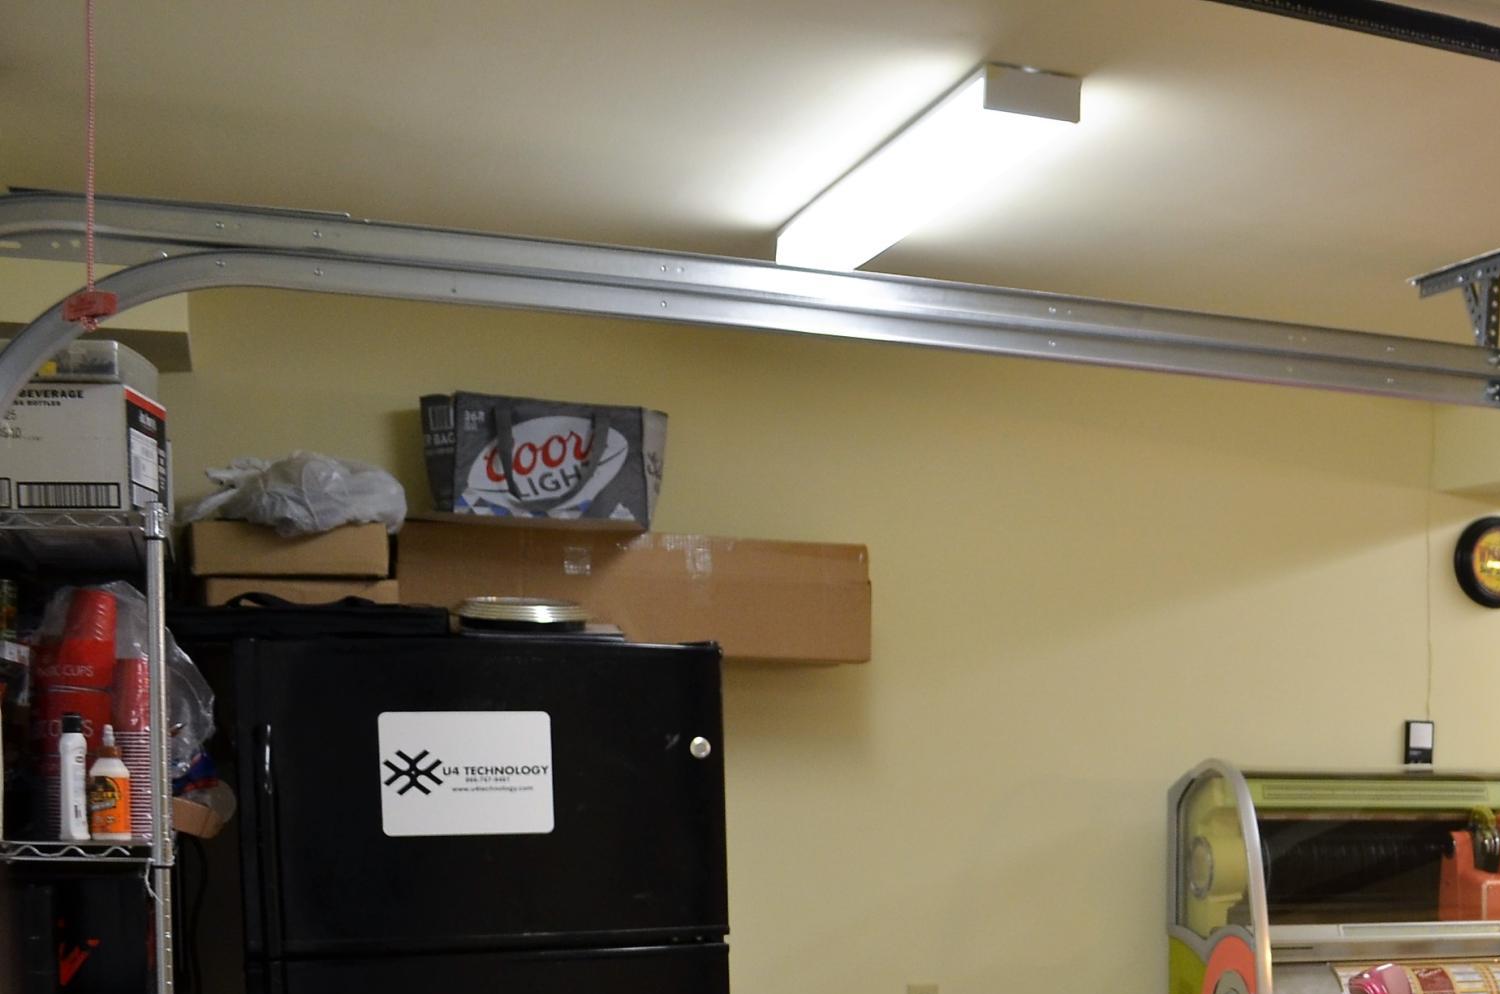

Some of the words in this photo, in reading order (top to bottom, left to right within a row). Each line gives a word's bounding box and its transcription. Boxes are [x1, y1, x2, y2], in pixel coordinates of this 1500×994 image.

[18, 388, 84, 399] BEVERAGE
[27, 399, 61, 407] BOTTLES
[484, 430, 596, 483] Coor
[517, 461, 590, 498] LIGH
[442, 766, 460, 776] U4
[464, 765, 549, 776] TECHNOLOGY
